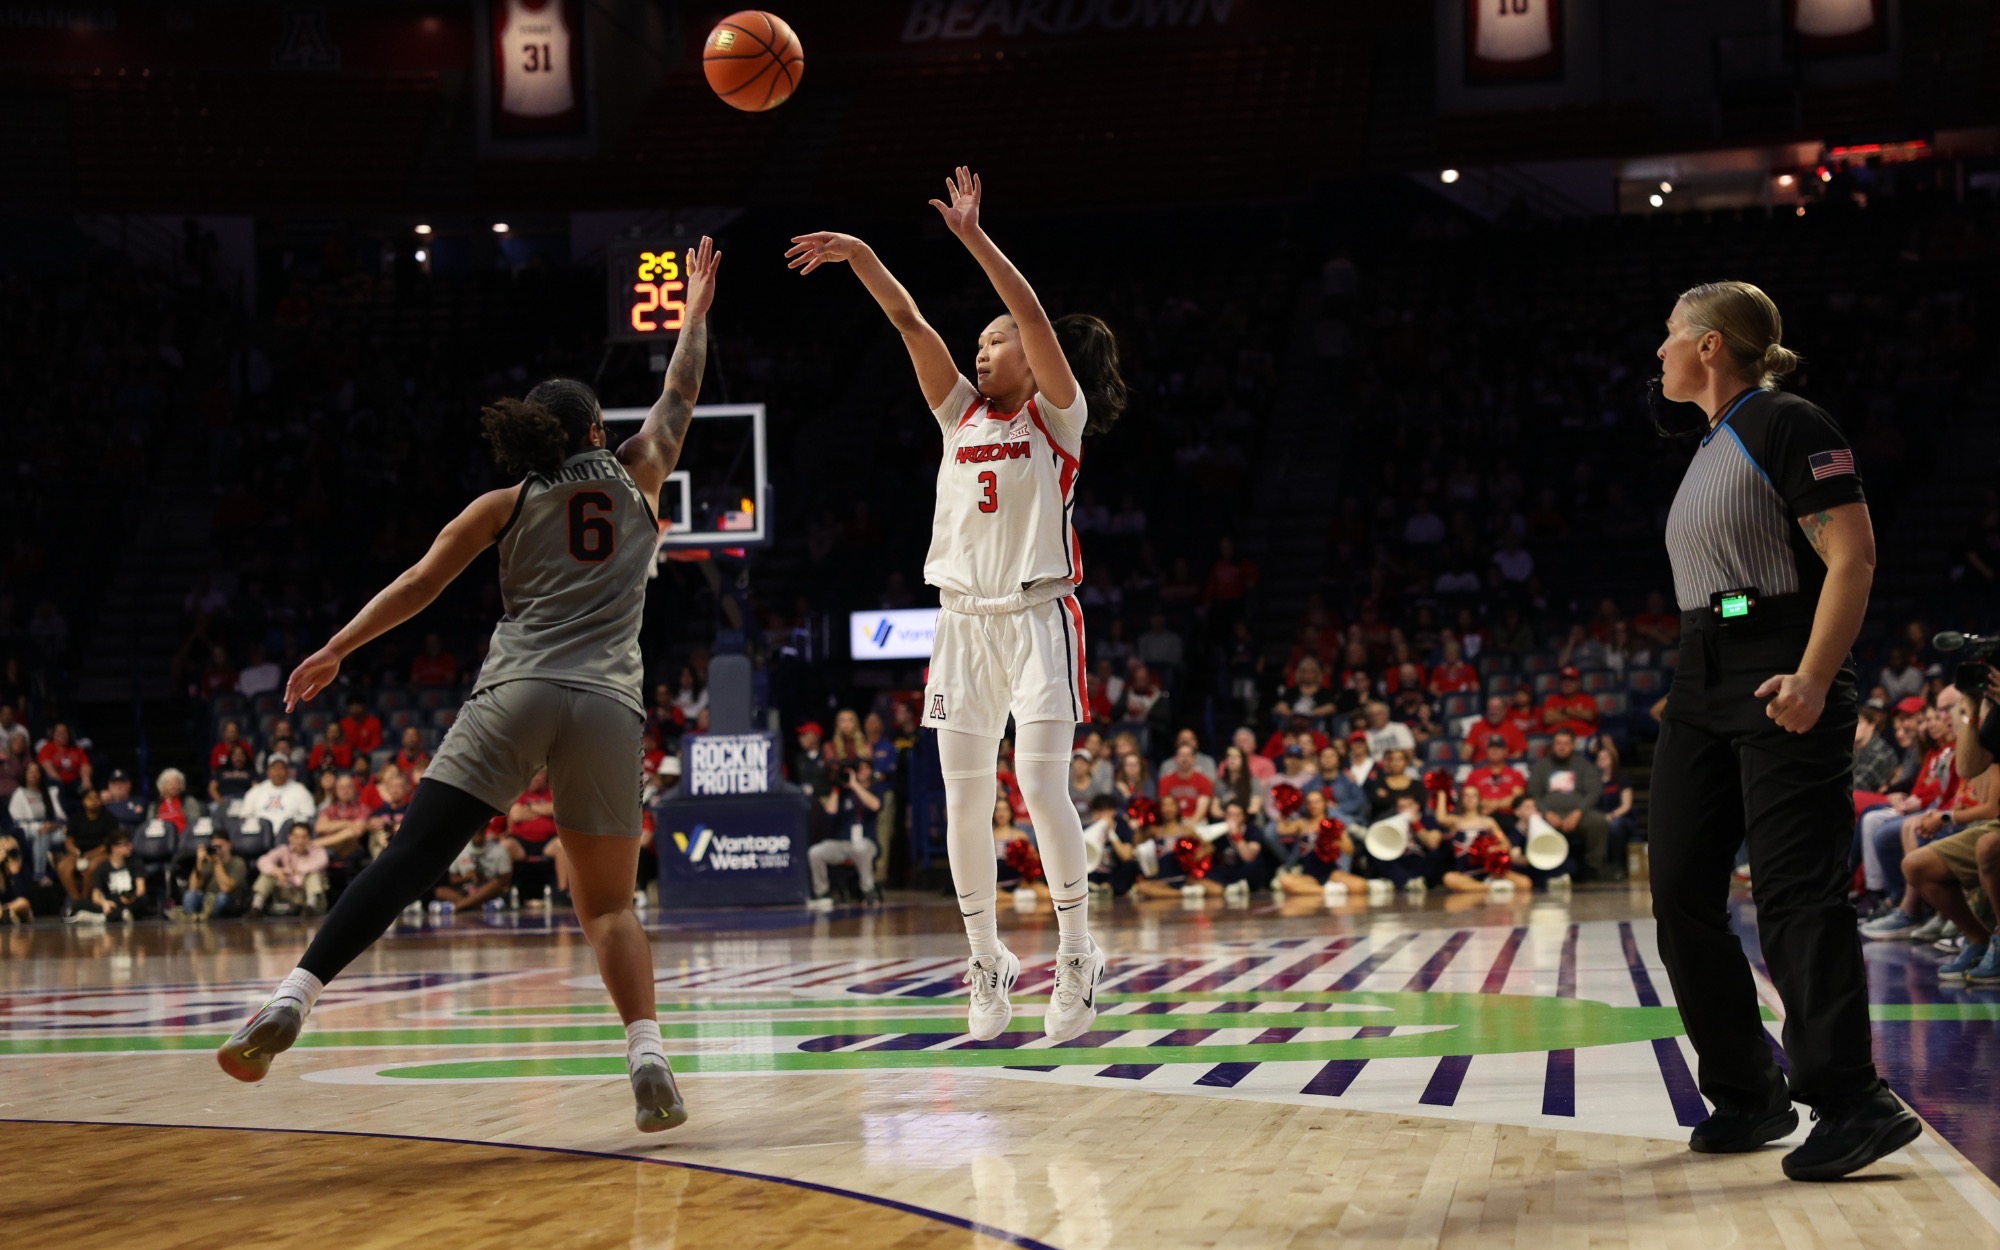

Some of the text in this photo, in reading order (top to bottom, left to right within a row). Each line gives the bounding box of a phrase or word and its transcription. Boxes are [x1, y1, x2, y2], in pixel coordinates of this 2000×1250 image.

[523, 44, 552, 73] 31
[631, 281, 687, 331] 25
[955, 441, 1031, 465] ARIZONA
[978, 471, 998, 513] 3
[568, 490, 614, 562] 6
[930, 694, 946, 720] A
[691, 740, 771, 769] ROCKIN'
[691, 767, 768, 795] PROTEIN
[711, 835, 791, 854] Vantage
[709, 852, 758, 870] West
